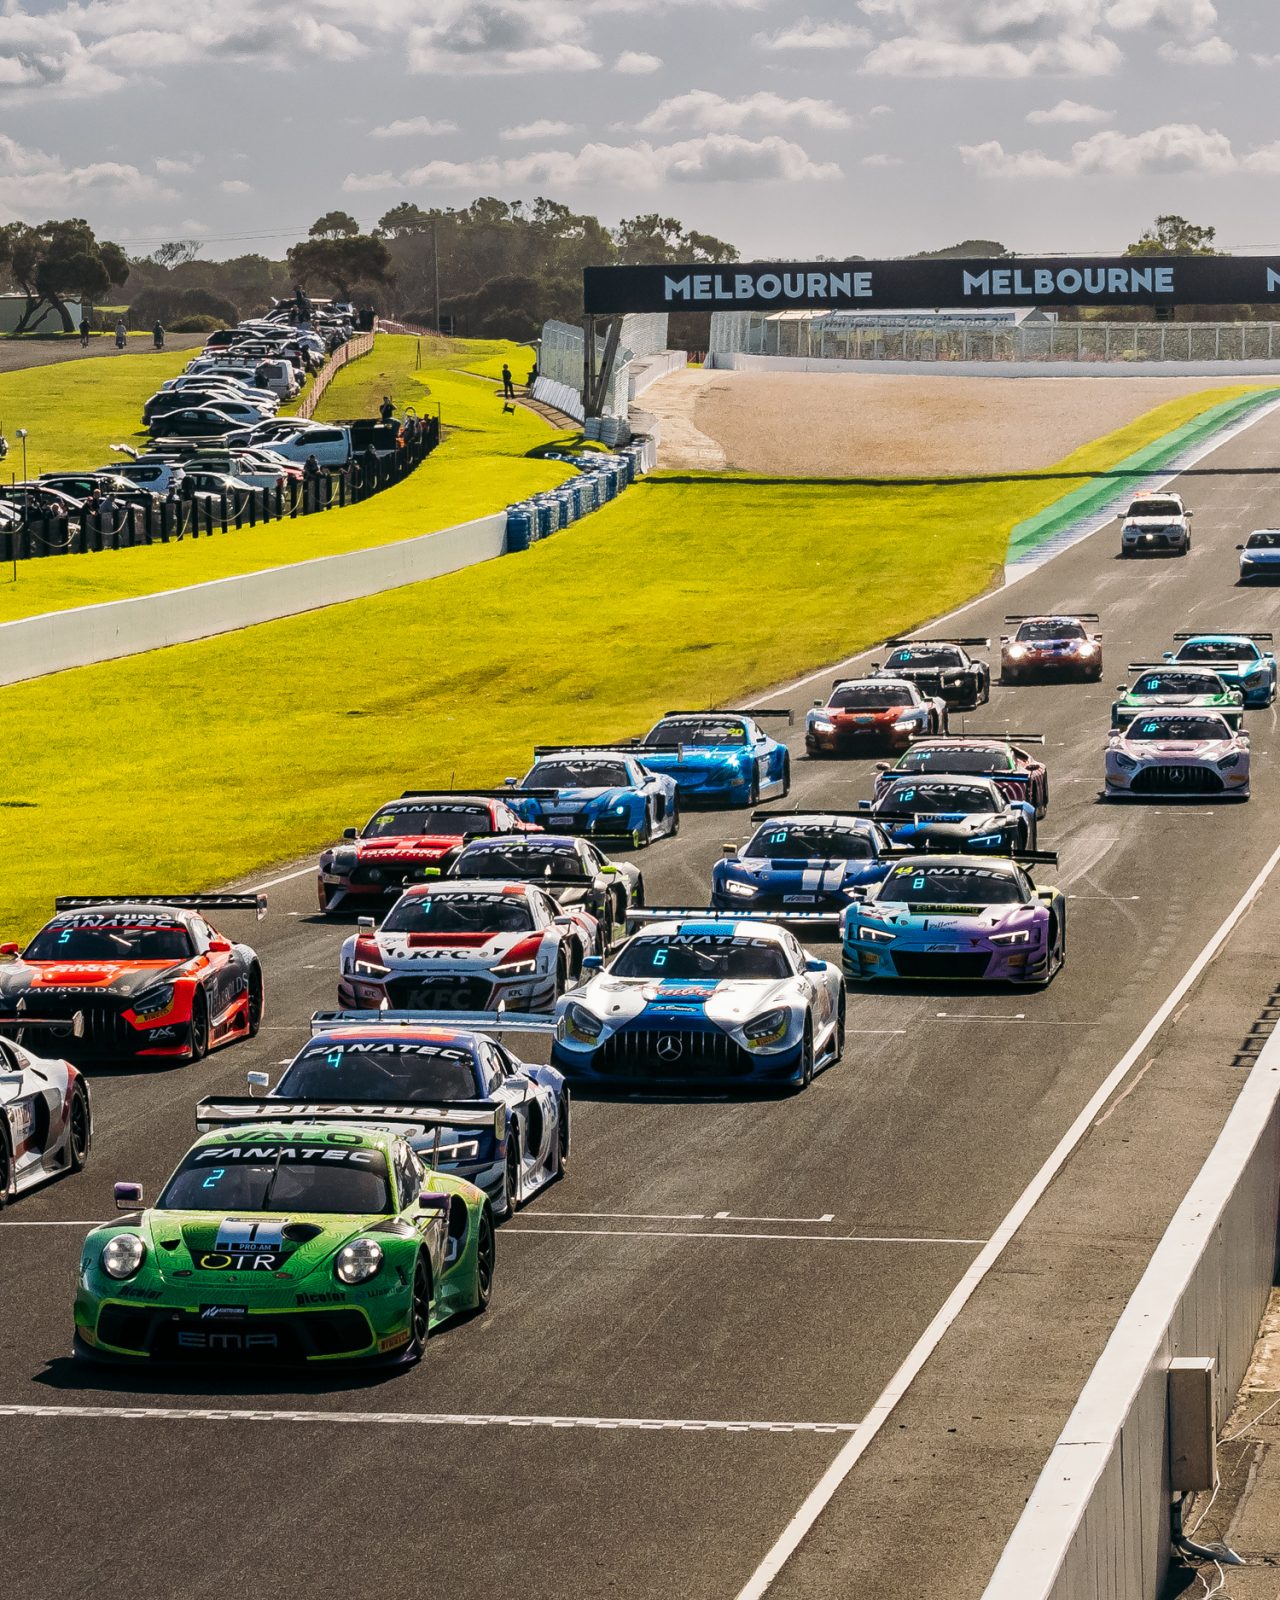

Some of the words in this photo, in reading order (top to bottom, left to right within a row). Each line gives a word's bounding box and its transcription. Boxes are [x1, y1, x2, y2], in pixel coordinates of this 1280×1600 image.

[665, 272, 872, 300] MELBOURNE
[963, 268, 1174, 295] MELBOURNE
[894, 784, 986, 794] FANATEC
[899, 790, 914, 801] 12
[381, 805, 482, 815] FANATEC
[761, 824, 867, 837] FANATEC
[770, 832, 786, 844] 10
[462, 846, 570, 858] FANATEC
[913, 878, 924, 889] 8
[401, 894, 522, 908] FANATEC
[422, 902, 431, 913] 7
[48, 919, 177, 930] FANATEC
[58, 929, 74, 944] 5
[635, 935, 771, 948] FANATEC
[408, 951, 470, 960] KFC
[652, 949, 669, 966] 6
[16, 986, 118, 994] HARROLDS
[304, 1043, 466, 1060] FANATEC
[327, 1053, 342, 1068] 4
[255, 1104, 447, 1116] PILATUS
[223, 1130, 364, 1144] VALO
[194, 1147, 375, 1164] FANATEC
[202, 1168, 225, 1188] 2
[245, 1223, 259, 1242] 1
[238, 1243, 272, 1251] PRO-AM
